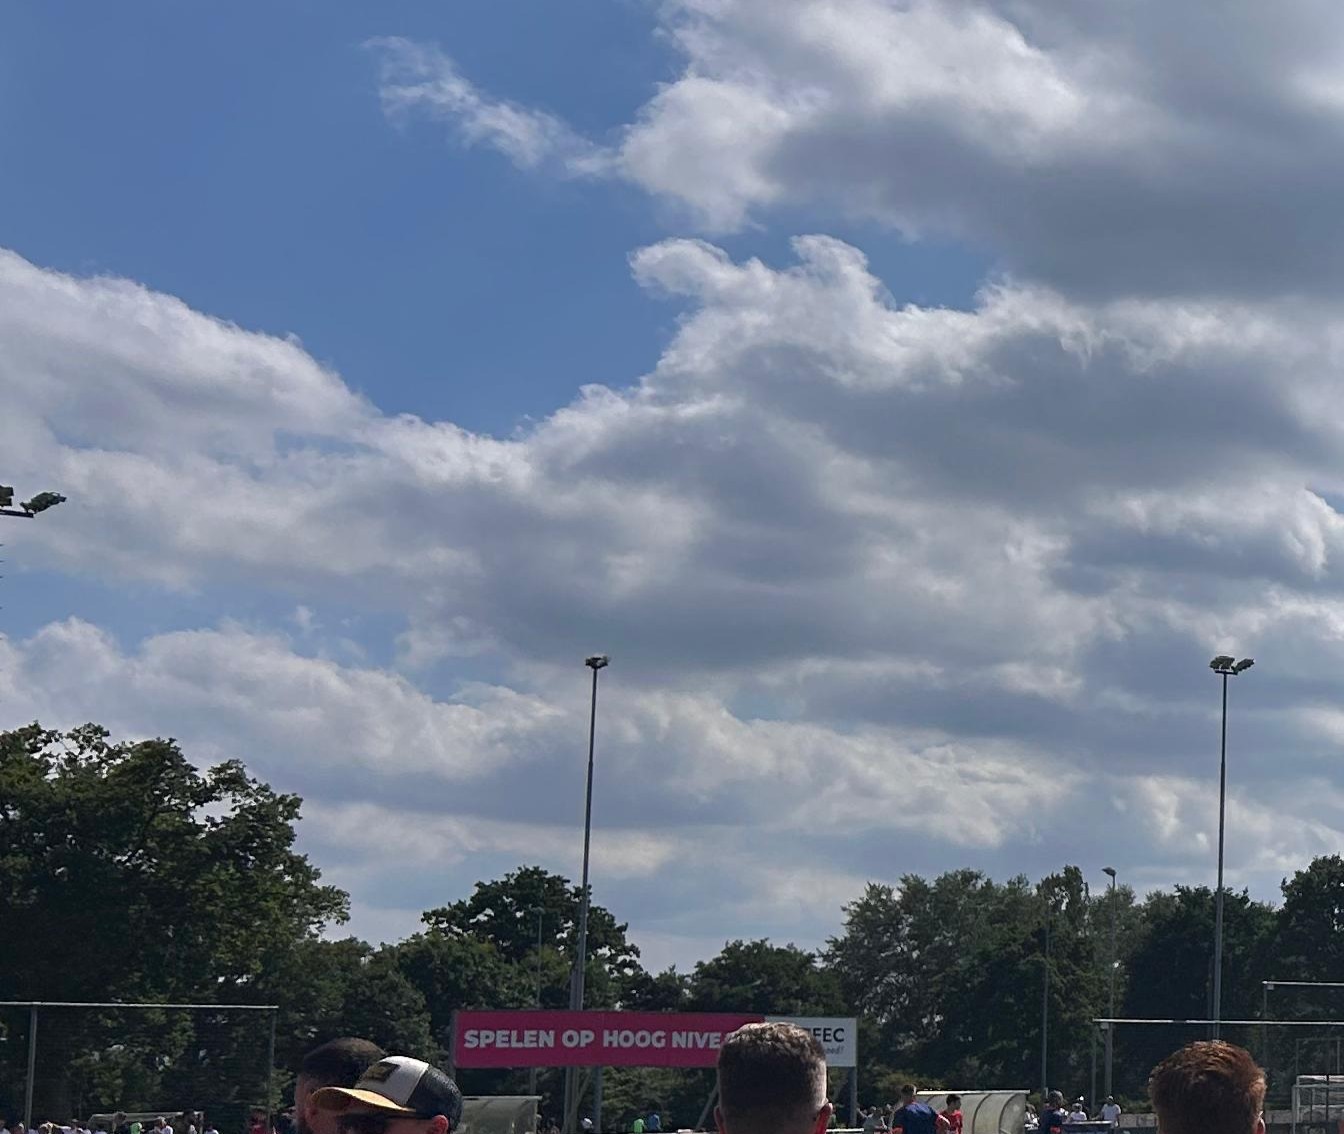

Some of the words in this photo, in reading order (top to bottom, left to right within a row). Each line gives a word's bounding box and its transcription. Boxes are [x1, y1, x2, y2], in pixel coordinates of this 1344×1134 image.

[464, 1030, 555, 1048] SPELEN
[562, 1030, 595, 1048] OP
[603, 1031, 666, 1048] HOOG
[672, 1032, 721, 1049] NIVE
